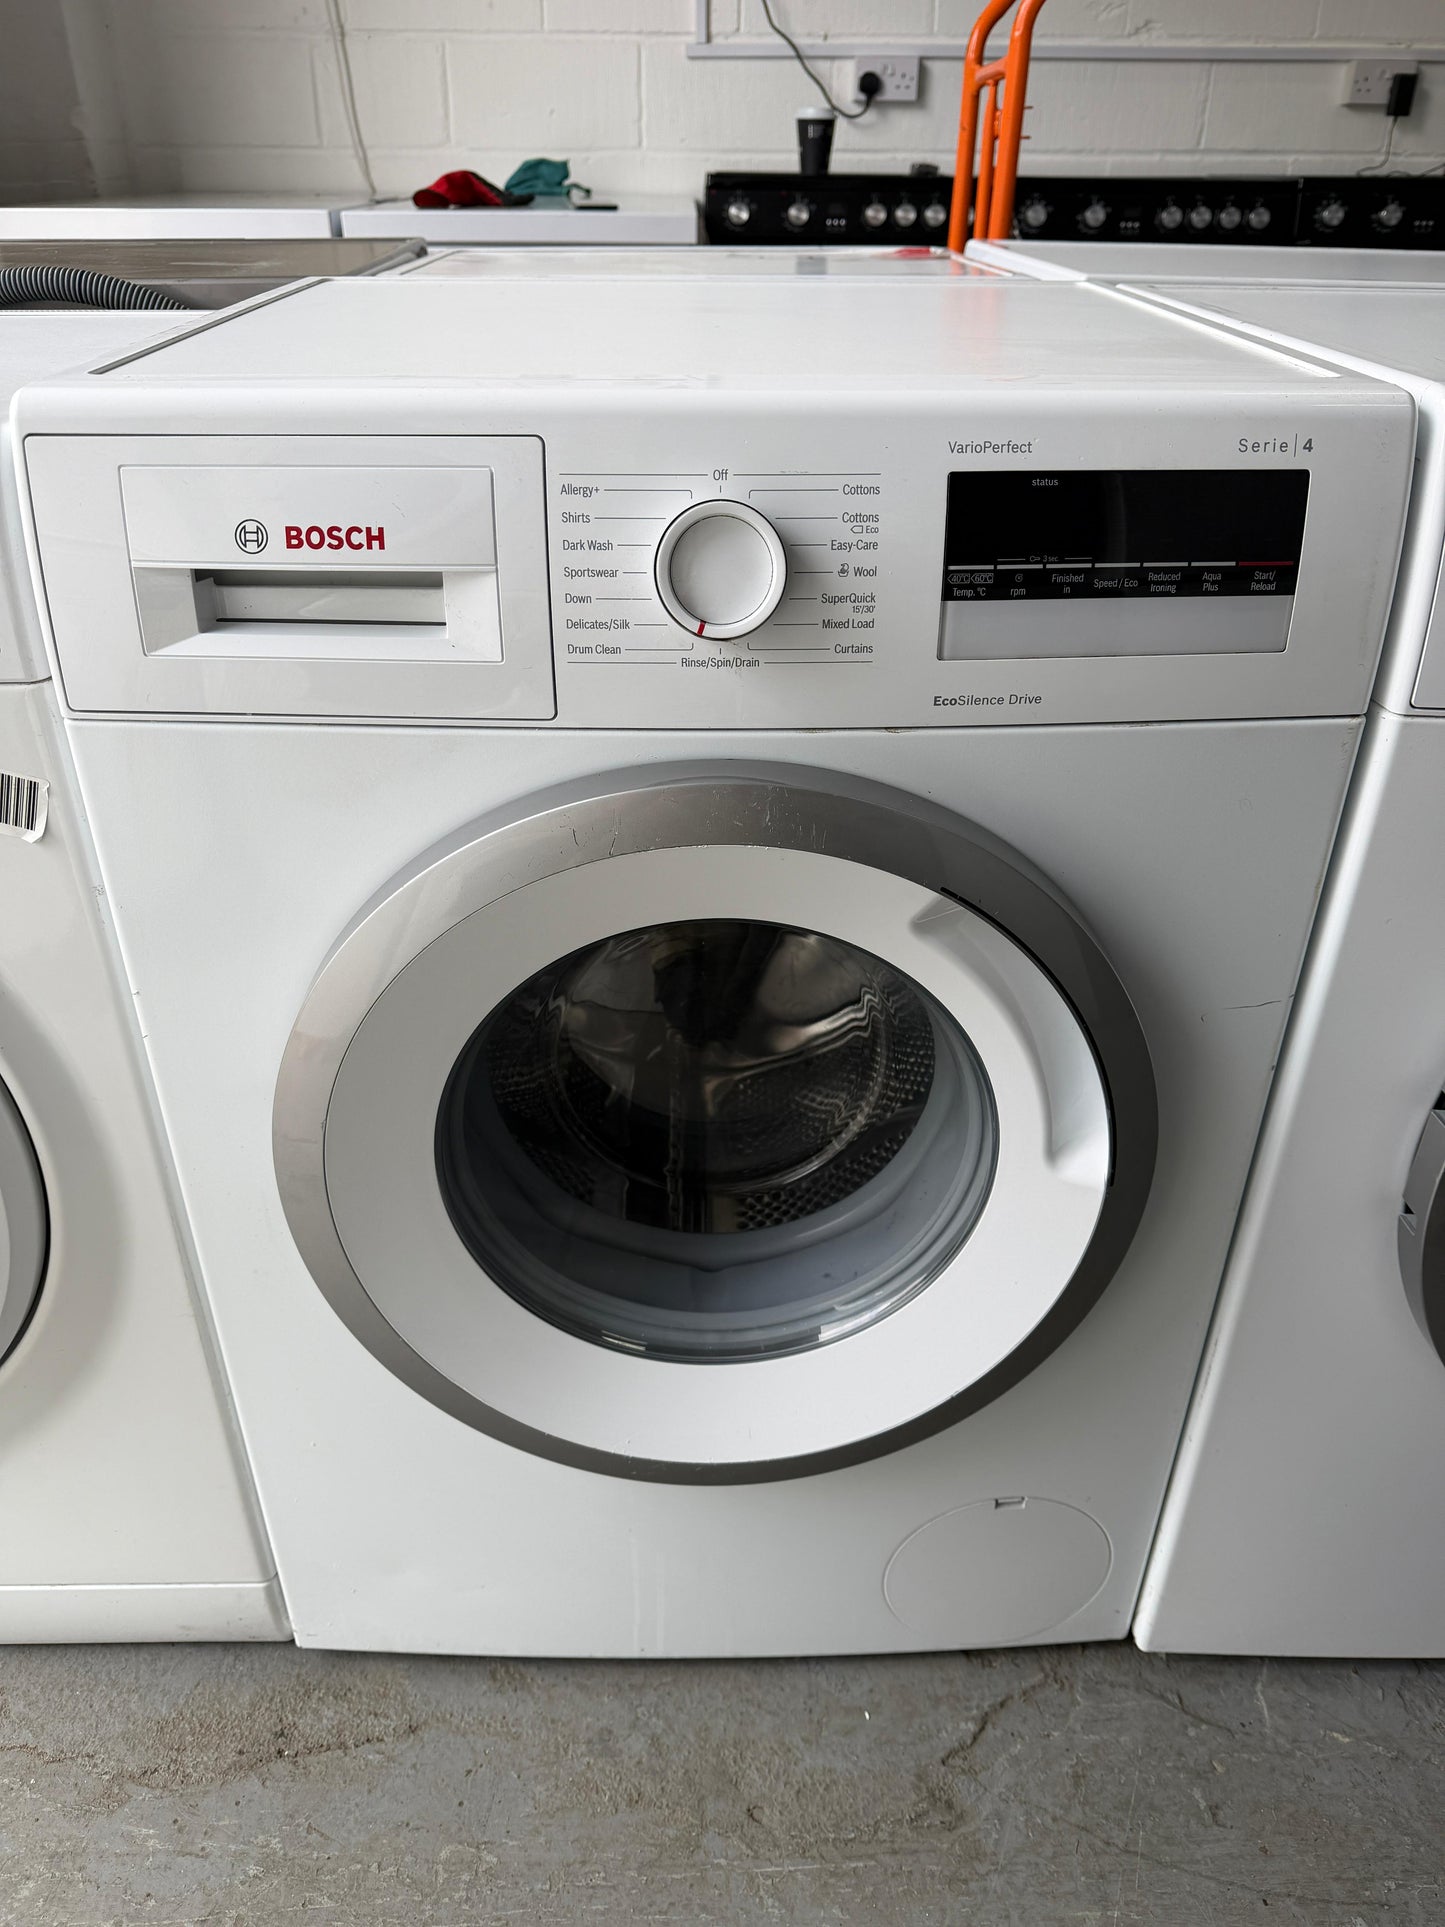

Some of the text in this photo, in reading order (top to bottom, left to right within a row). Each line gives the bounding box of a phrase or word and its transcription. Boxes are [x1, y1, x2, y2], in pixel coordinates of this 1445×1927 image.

[948, 440, 1032, 454] VarioPerfect
[713, 469, 728, 481] Off
[1032, 478, 1059, 486] status
[560, 484, 600, 498] Allergy+
[842, 484, 880, 495] Cottons
[562, 512, 590, 523] Shirts
[842, 512, 880, 523] Cottons
[866, 525, 879, 534] Eco
[285, 526, 386, 550] BOSCH
[562, 540, 613, 551] Dark Wash
[831, 540, 878, 552] Easy-Care
[564, 567, 619, 579] Sportswear
[854, 566, 877, 577] Wool
[1148, 572, 1181, 581] Reduced
[1254, 571, 1276, 581] Start/
[1052, 573, 1084, 583] Finished
[1202, 572, 1222, 582] Aqua
[1094, 578, 1118, 588] Speed
[1124, 578, 1138, 587] Eco
[1203, 582, 1218, 591] Plus
[1250, 581, 1276, 591] Reload
[953, 588, 975, 598] Temp.
[1010, 588, 1026, 597] rpm
[1063, 585, 1070, 594] in
[1150, 584, 1177, 594] Ironing
[565, 594, 592, 604] Down
[821, 593, 876, 605] SuperQuick
[566, 619, 630, 631] Delicates/Silk
[822, 619, 875, 629] Mixed Load
[568, 645, 621, 654] Drum Clean
[834, 643, 873, 654] Curtains
[681, 657, 760, 669] Rinse/Spin/Drain
[933, 693, 1042, 706] EcoSilence Drive
